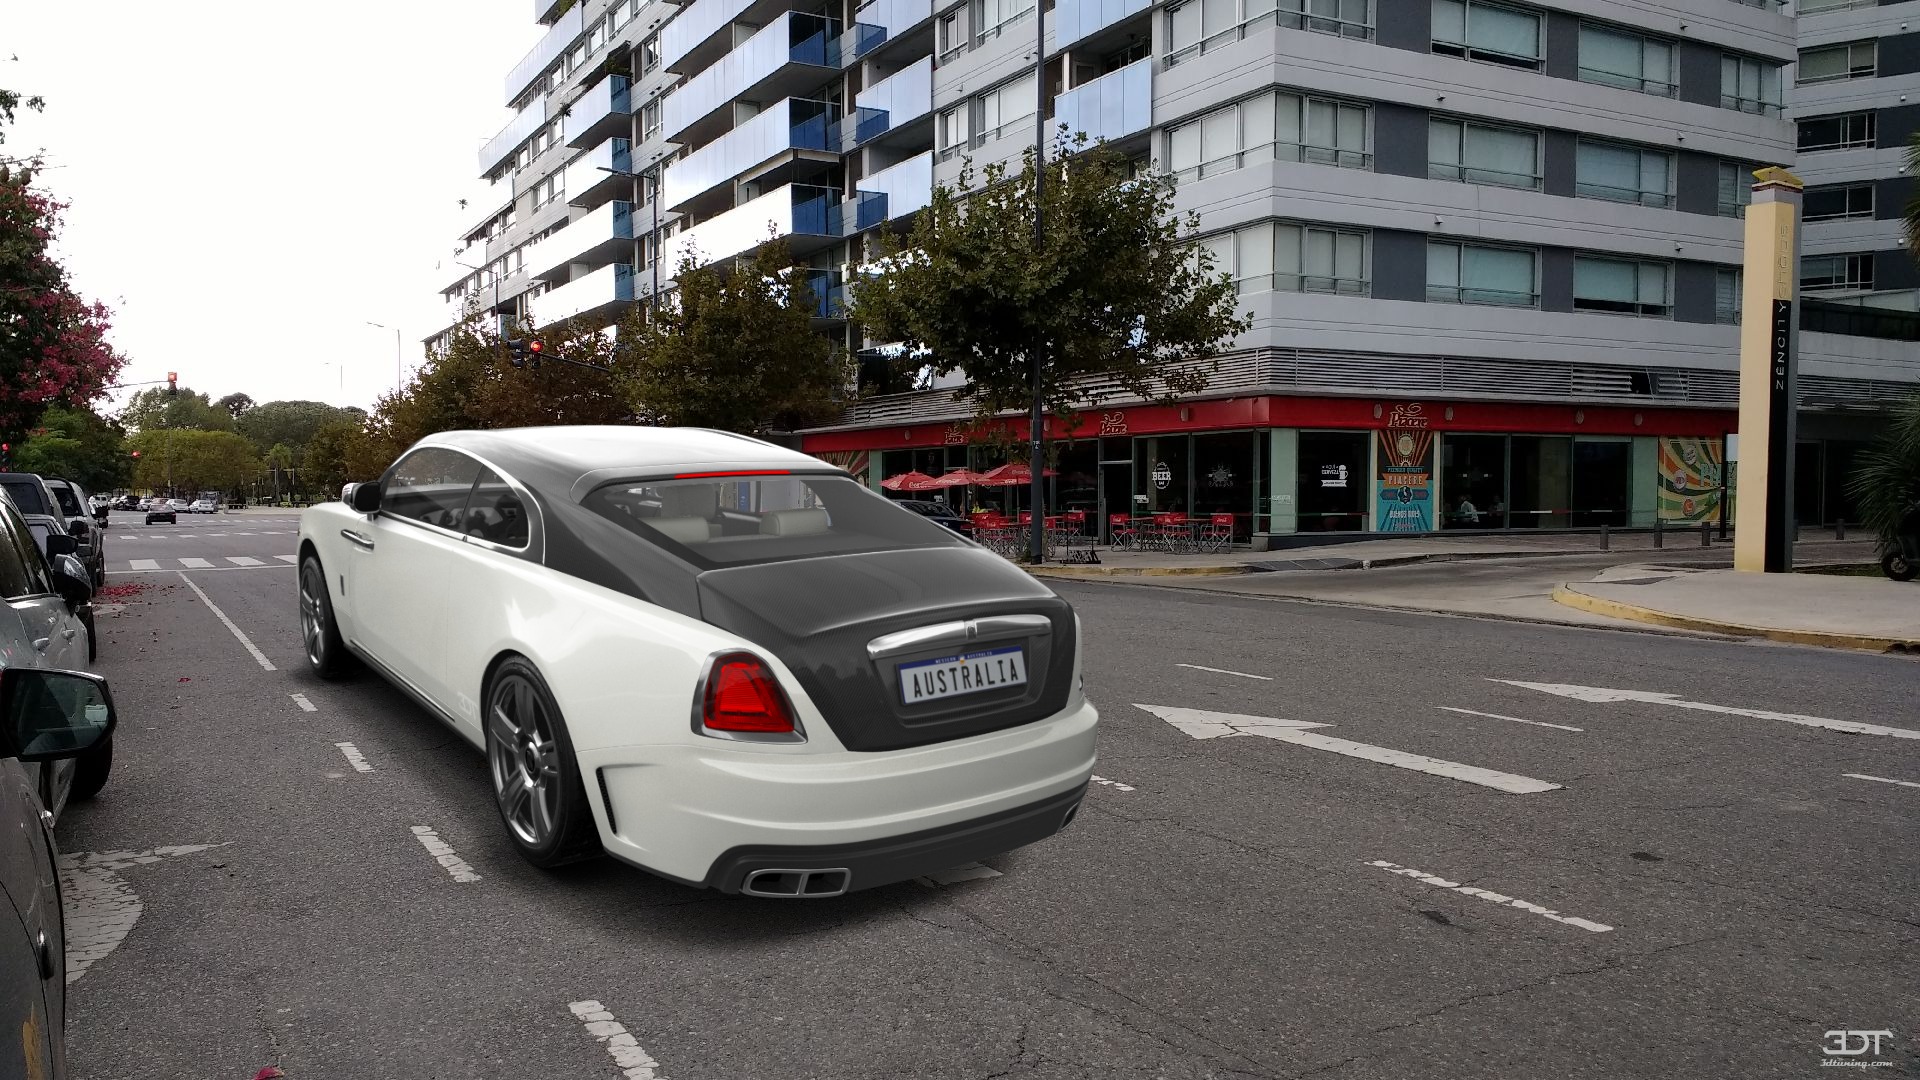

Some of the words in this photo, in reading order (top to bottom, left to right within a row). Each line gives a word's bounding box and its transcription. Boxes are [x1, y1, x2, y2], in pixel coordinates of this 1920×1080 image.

[1775, 301, 1787, 391] ZENCITY
[1152, 472, 1171, 480] BEER
[914, 658, 1018, 698] AUSTRALIA
